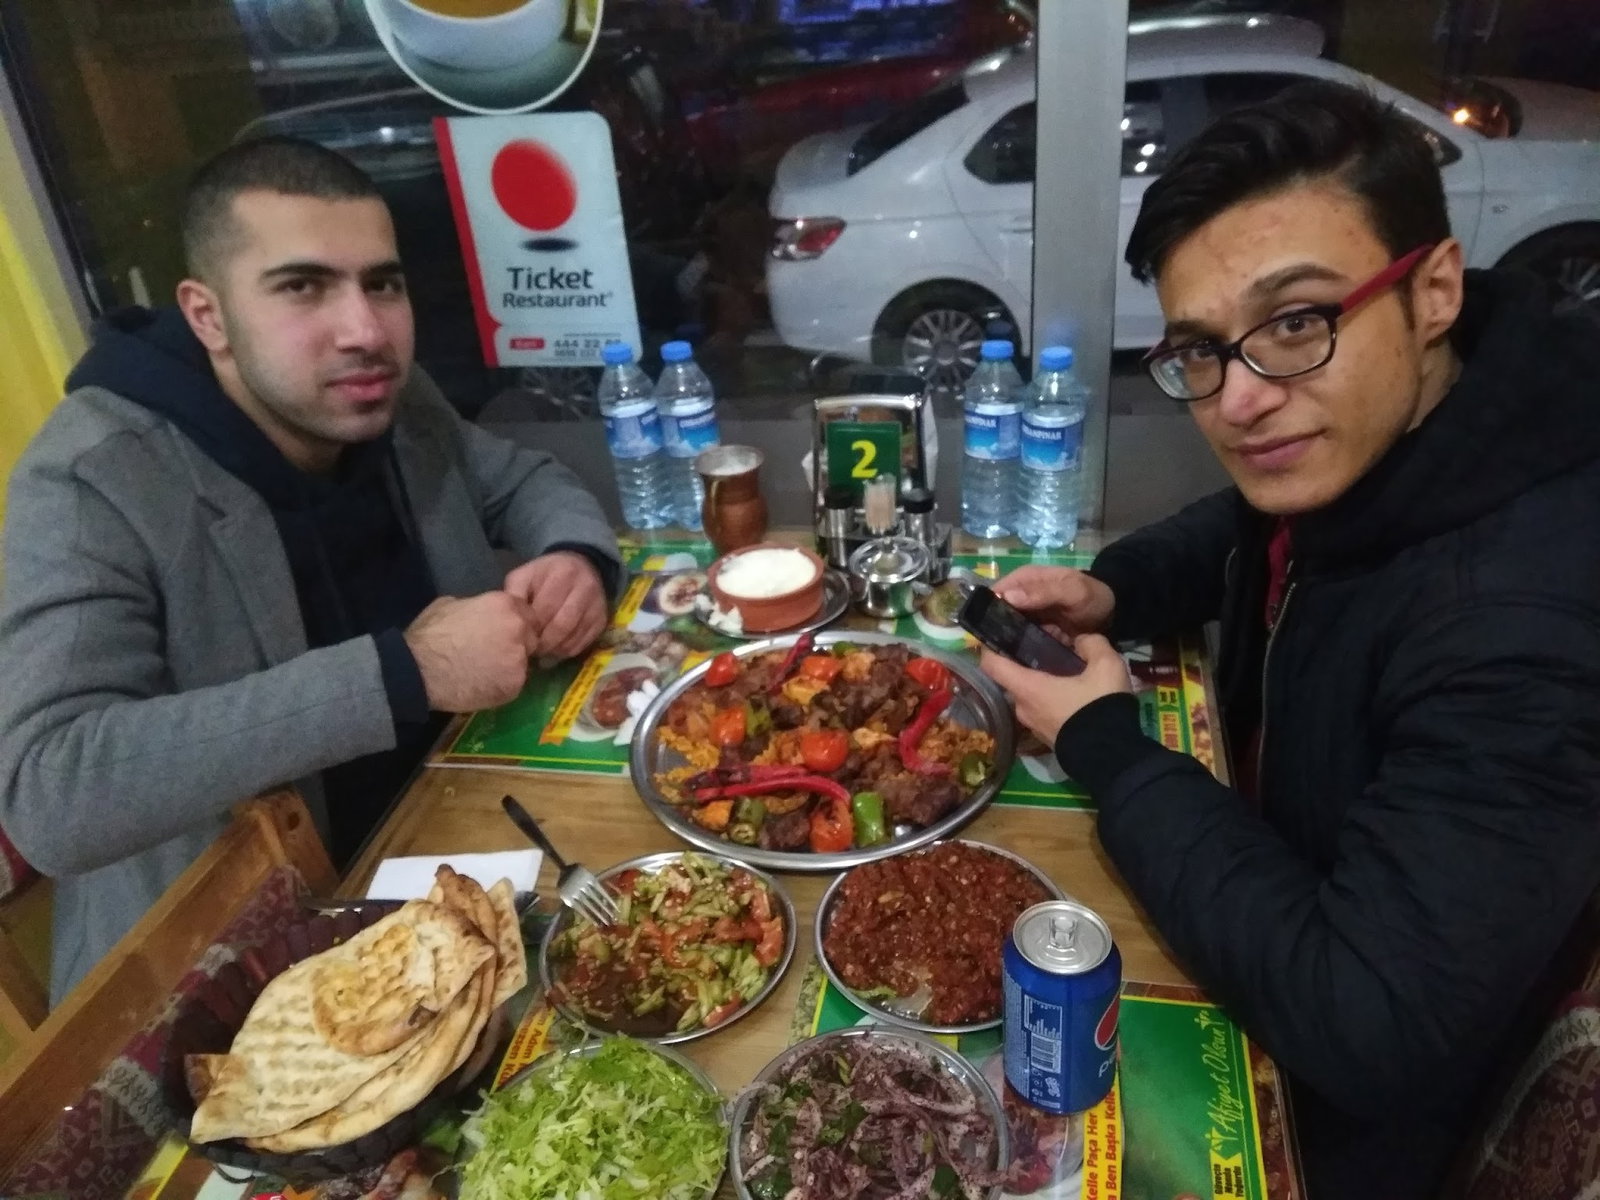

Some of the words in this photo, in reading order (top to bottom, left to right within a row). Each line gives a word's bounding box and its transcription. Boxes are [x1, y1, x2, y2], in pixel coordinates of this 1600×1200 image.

[506, 266, 593, 290] Ticket
[502, 291, 607, 308] Restaurant
[851, 440, 878, 478] 2
[1201, 1028, 1230, 1072] Olsun
[1207, 1072, 1244, 1133] Afiyet
[1087, 1112, 1098, 1135] Her
[1087, 1139, 1101, 1168] Paça
[1105, 1124, 1120, 1160] Başka
[1106, 1165, 1117, 1191] Ben
